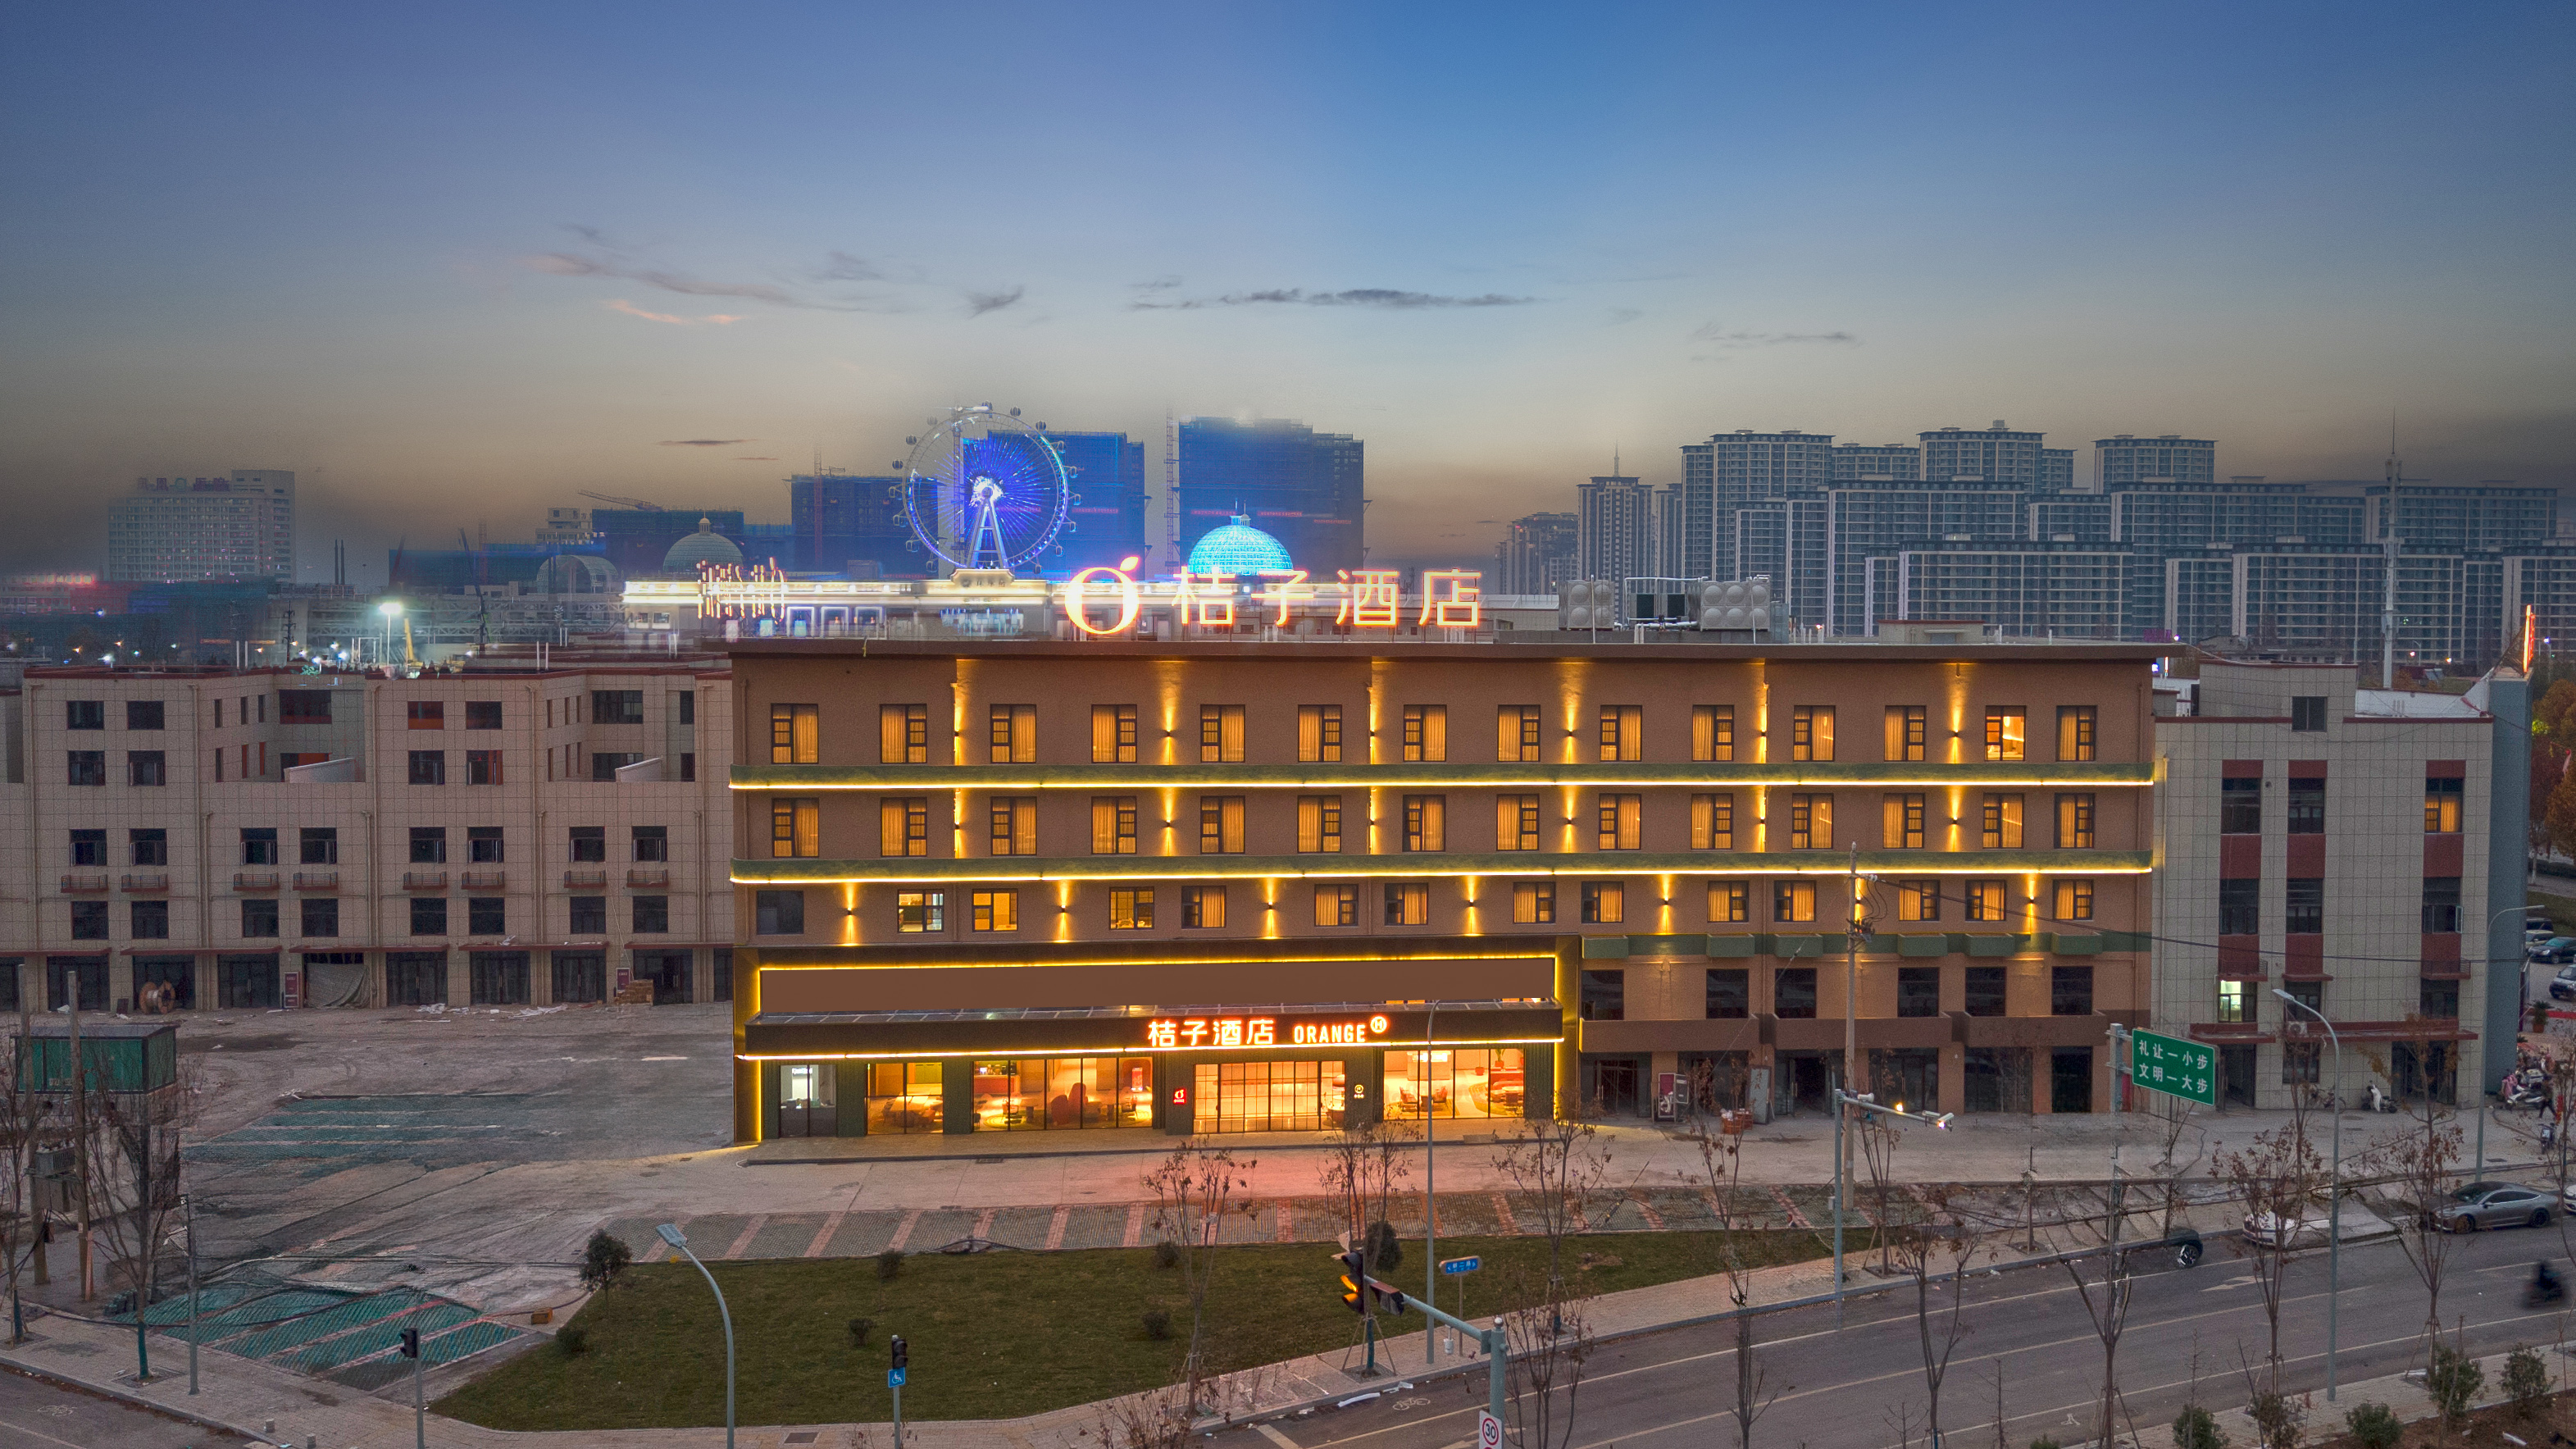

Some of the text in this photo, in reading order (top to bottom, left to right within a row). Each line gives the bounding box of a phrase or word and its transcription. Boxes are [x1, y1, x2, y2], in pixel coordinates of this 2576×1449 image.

[1172, 566, 1481, 627] 桔子酒店
[1148, 1019, 1274, 1047] 桔子酒店
[1294, 1024, 1366, 1044] ORANGE
[2138, 1039, 2208, 1069] 礼让一小步
[2138, 1063, 2208, 1093] 文明一大步
[1485, 1423, 1496, 1439] 30
